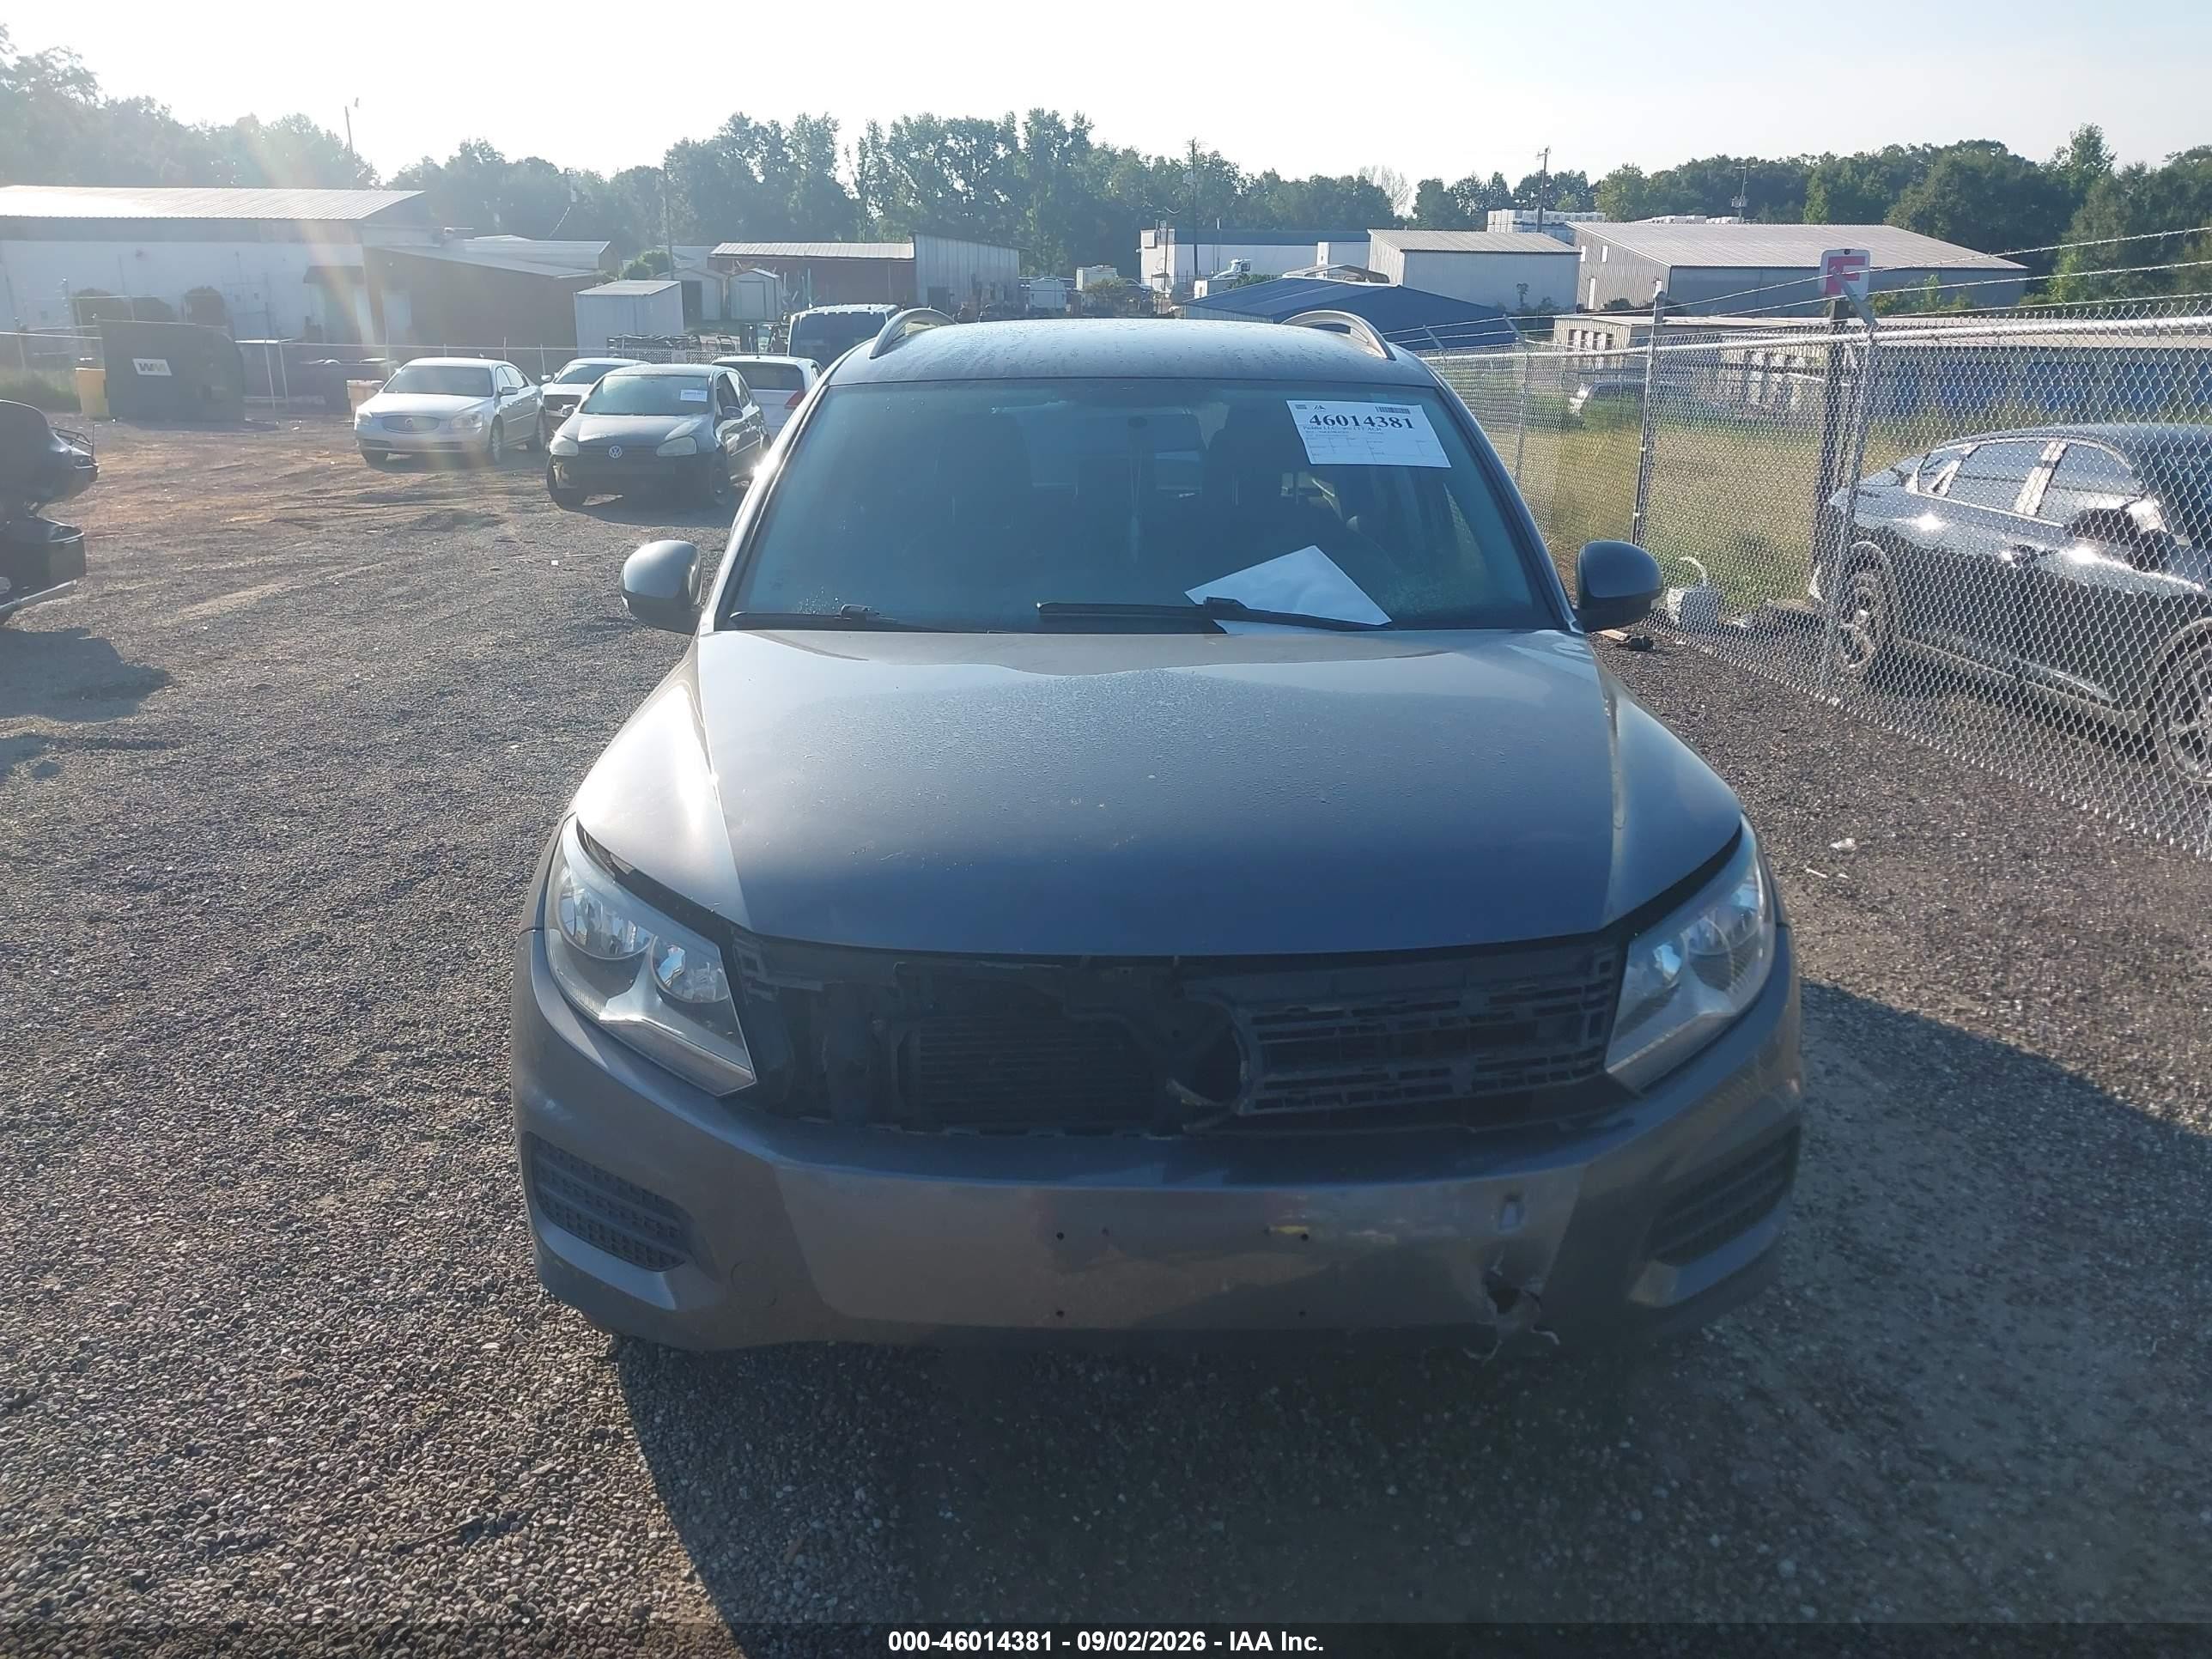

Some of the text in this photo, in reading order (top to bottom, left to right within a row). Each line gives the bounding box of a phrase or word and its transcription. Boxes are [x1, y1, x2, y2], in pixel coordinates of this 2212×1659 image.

[1826, 256, 1866, 295] F
[137, 362, 166, 372] WM
[1309, 414, 1415, 429] 46014381
[609, 445, 623, 459] VW
